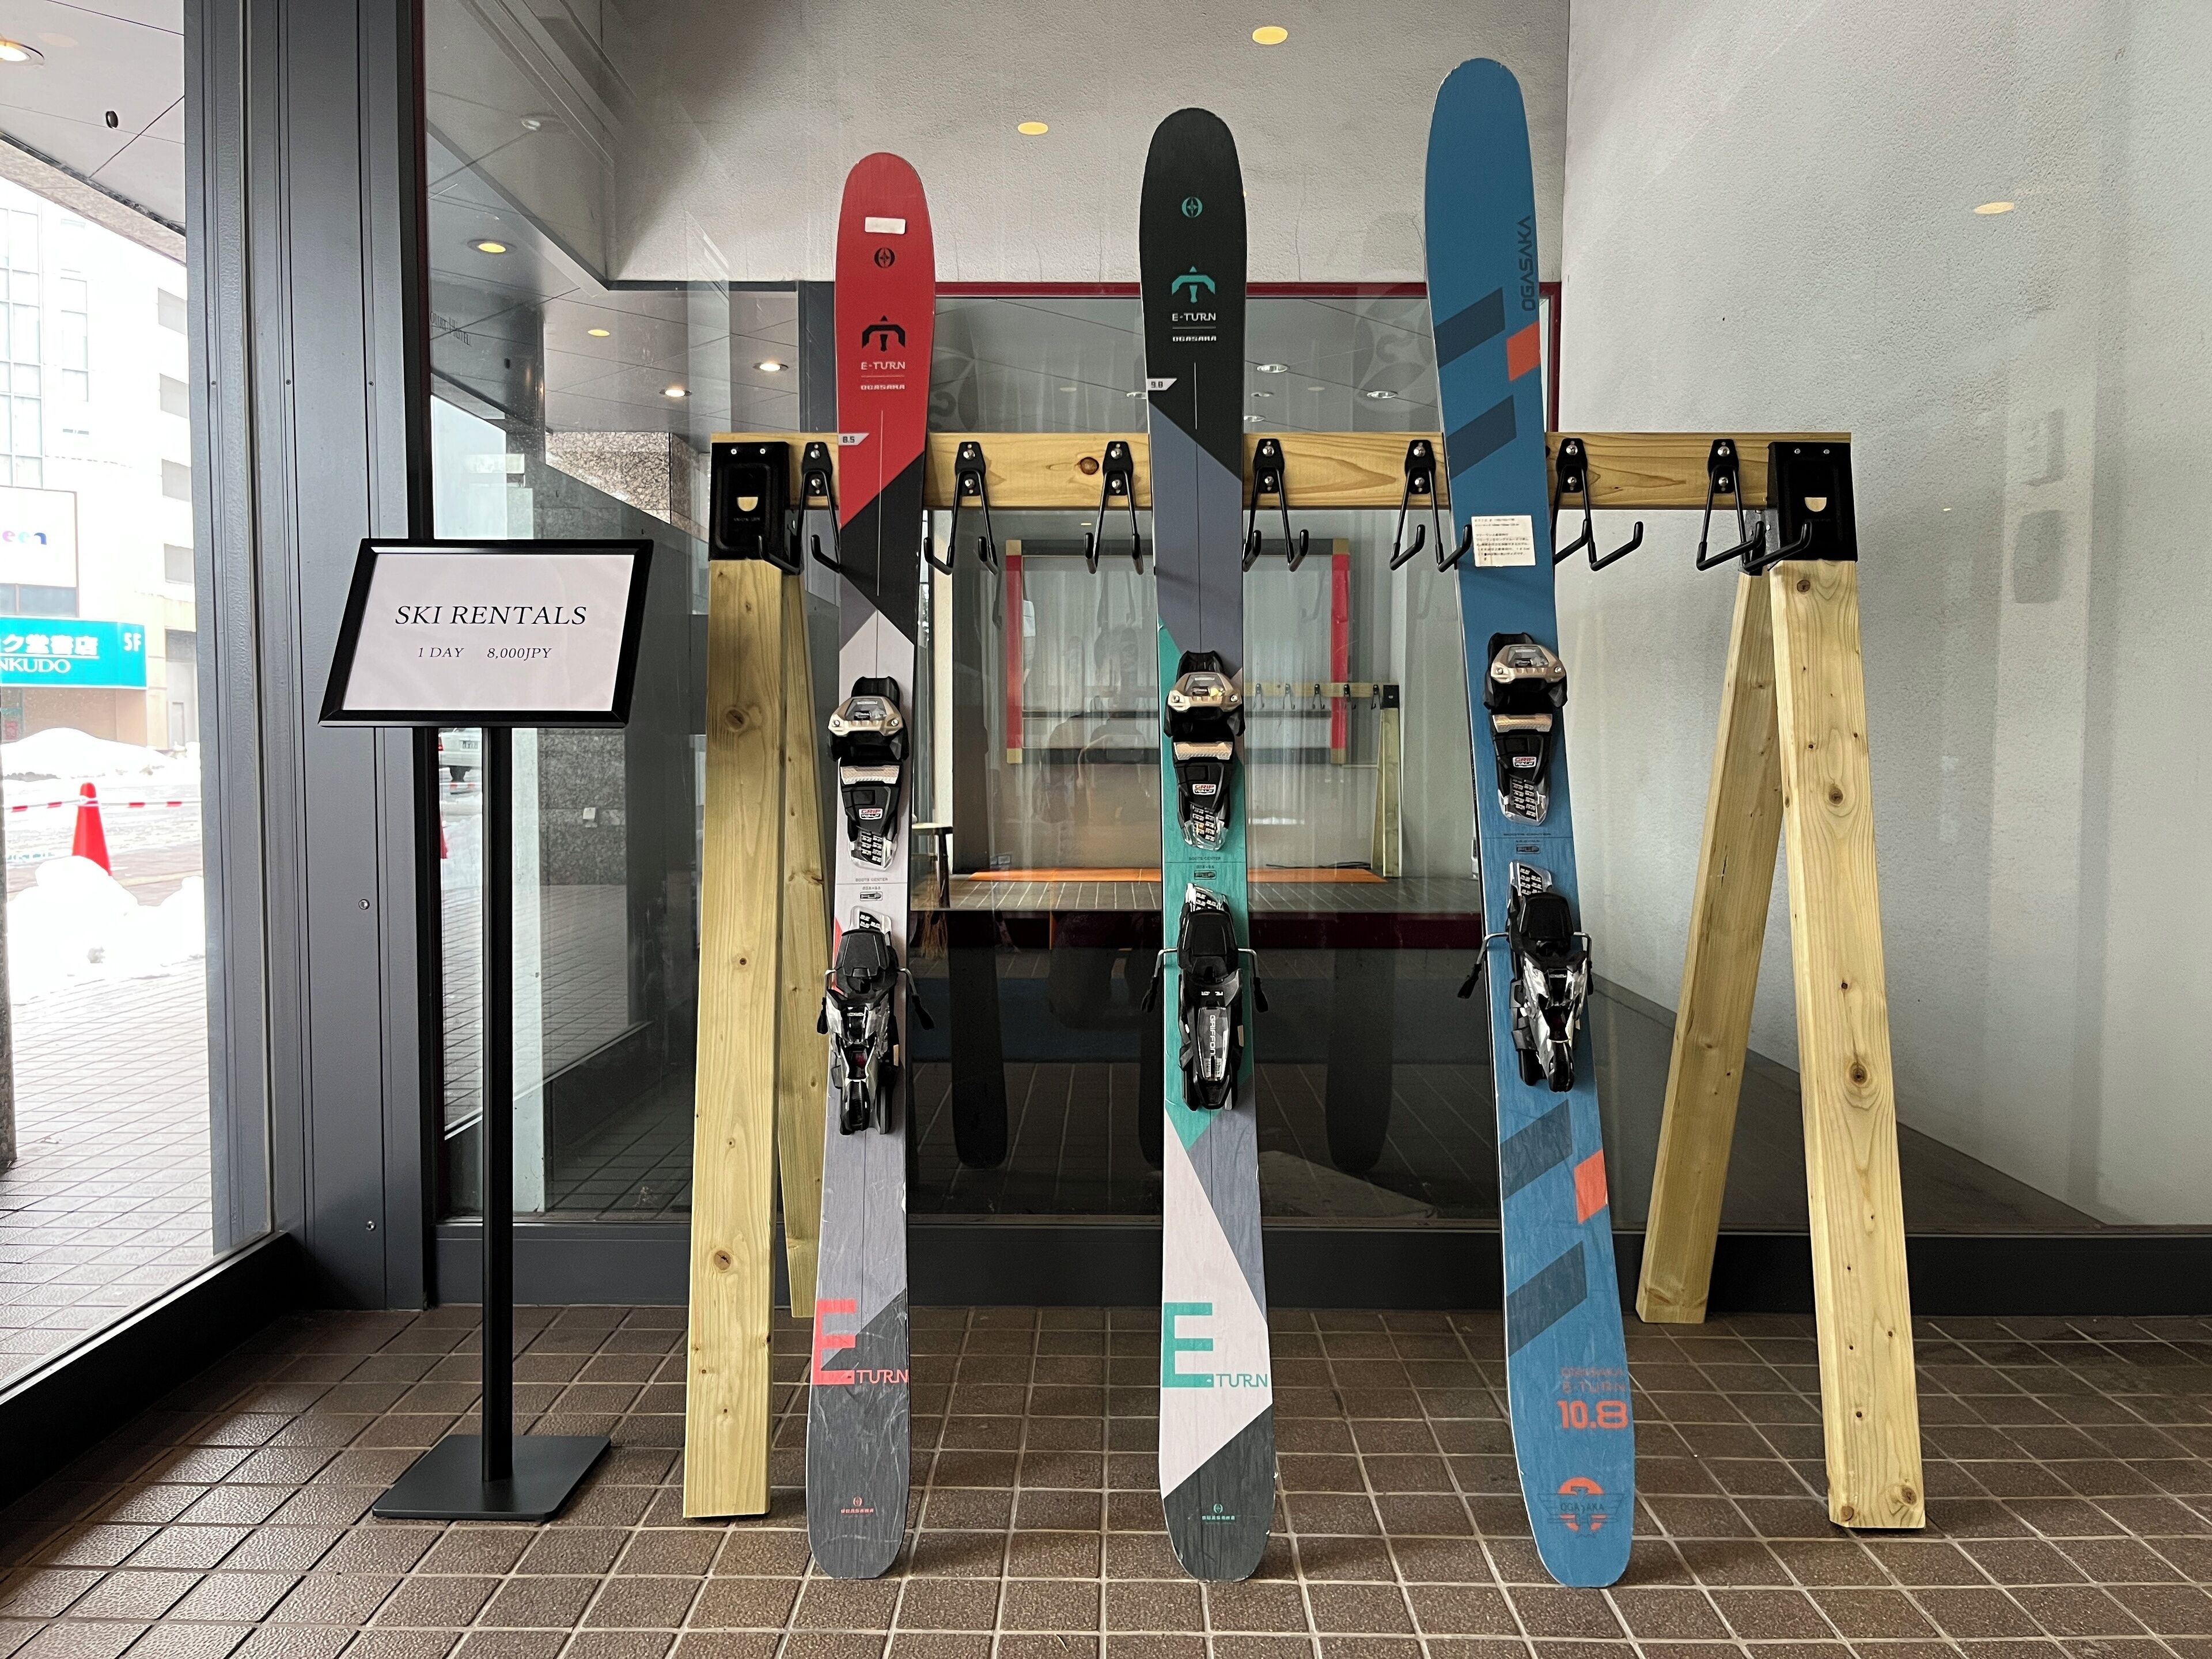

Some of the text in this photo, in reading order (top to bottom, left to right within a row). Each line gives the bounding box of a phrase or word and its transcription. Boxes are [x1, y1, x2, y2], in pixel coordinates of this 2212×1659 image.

[1517, 215, 1536, 312] OGASAKA
[1172, 312, 1216, 321] E-TURN
[861, 361, 906, 370] E-TURN
[395, 605, 587, 625] SKI RENTALS
[418, 647, 552, 661] 1 DAY 8,000JPY
[1557, 1400, 1628, 1429] 10.8
